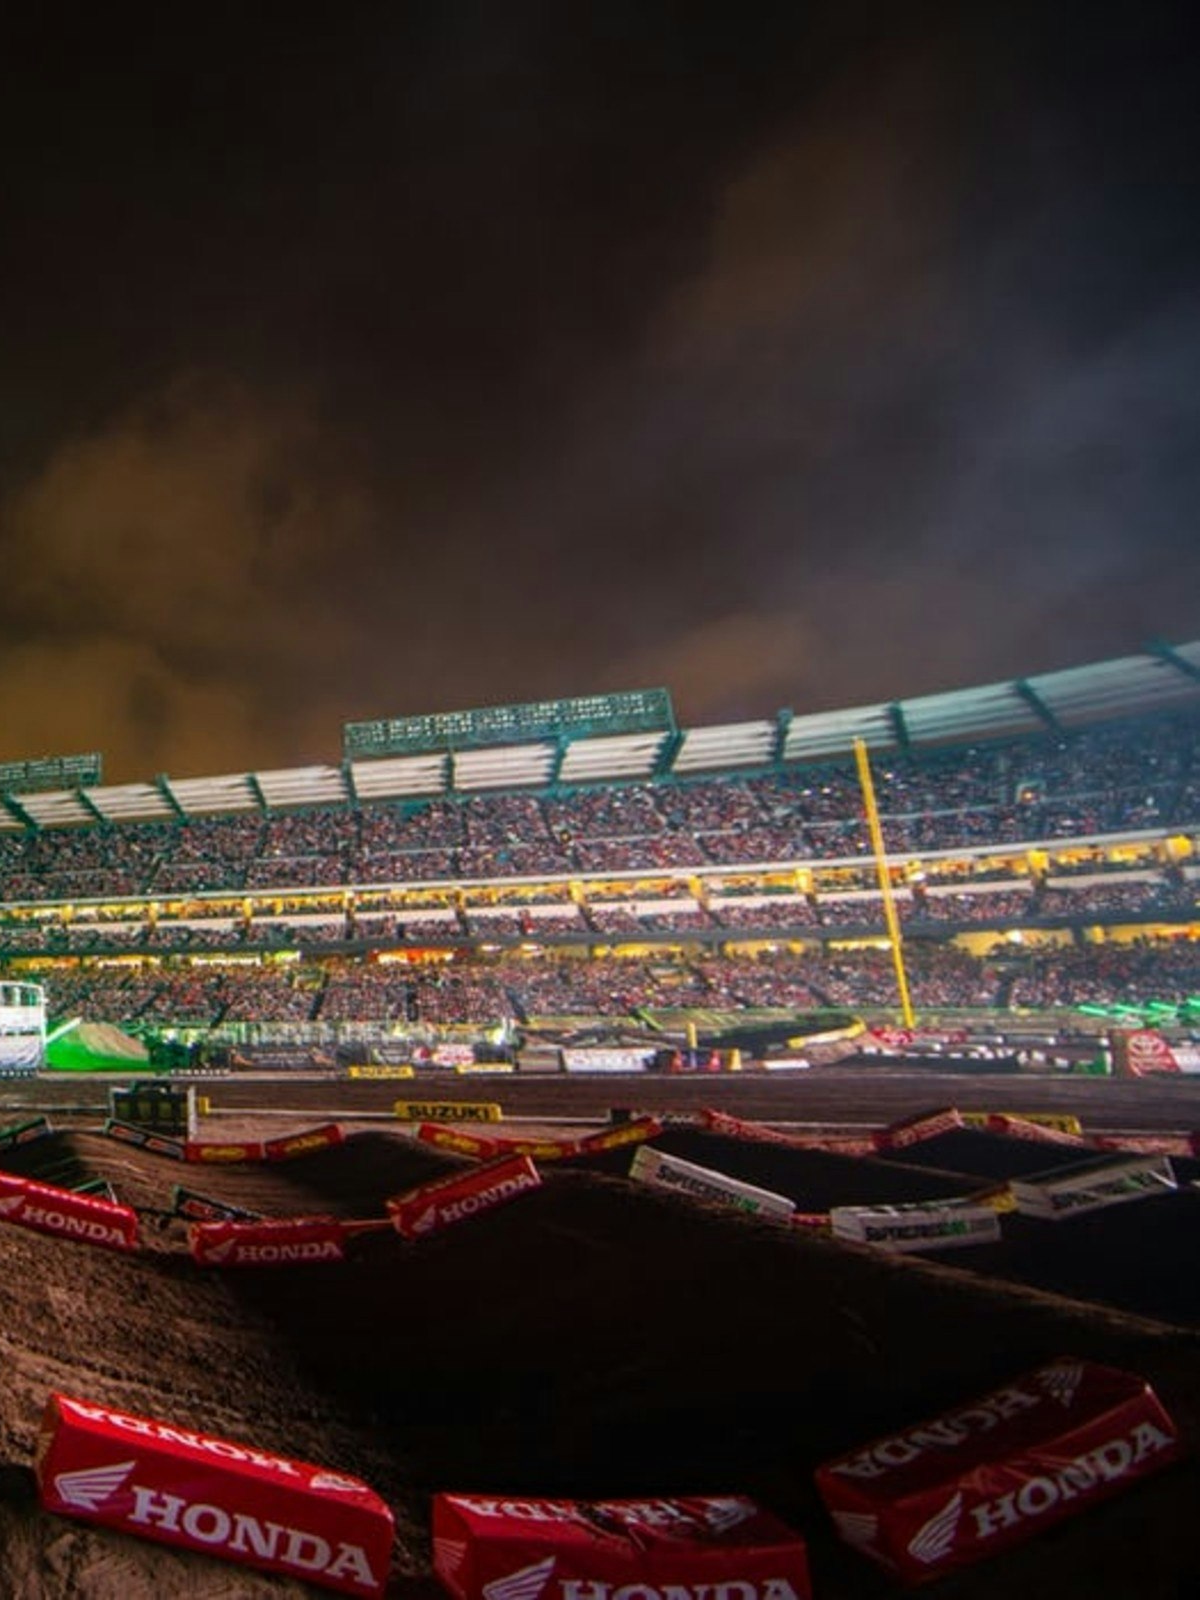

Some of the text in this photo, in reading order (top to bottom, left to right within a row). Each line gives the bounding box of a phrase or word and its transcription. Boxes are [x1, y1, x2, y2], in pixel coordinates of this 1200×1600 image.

[407, 1104, 492, 1119] SUZUKI
[438, 1172, 538, 1224] HONDA
[22, 1205, 126, 1244] HONDA
[233, 1239, 344, 1263] HONDA
[973, 1421, 1175, 1537] HONDA
[128, 1484, 380, 1587] HONDA
[558, 1577, 798, 1600] HONDA
